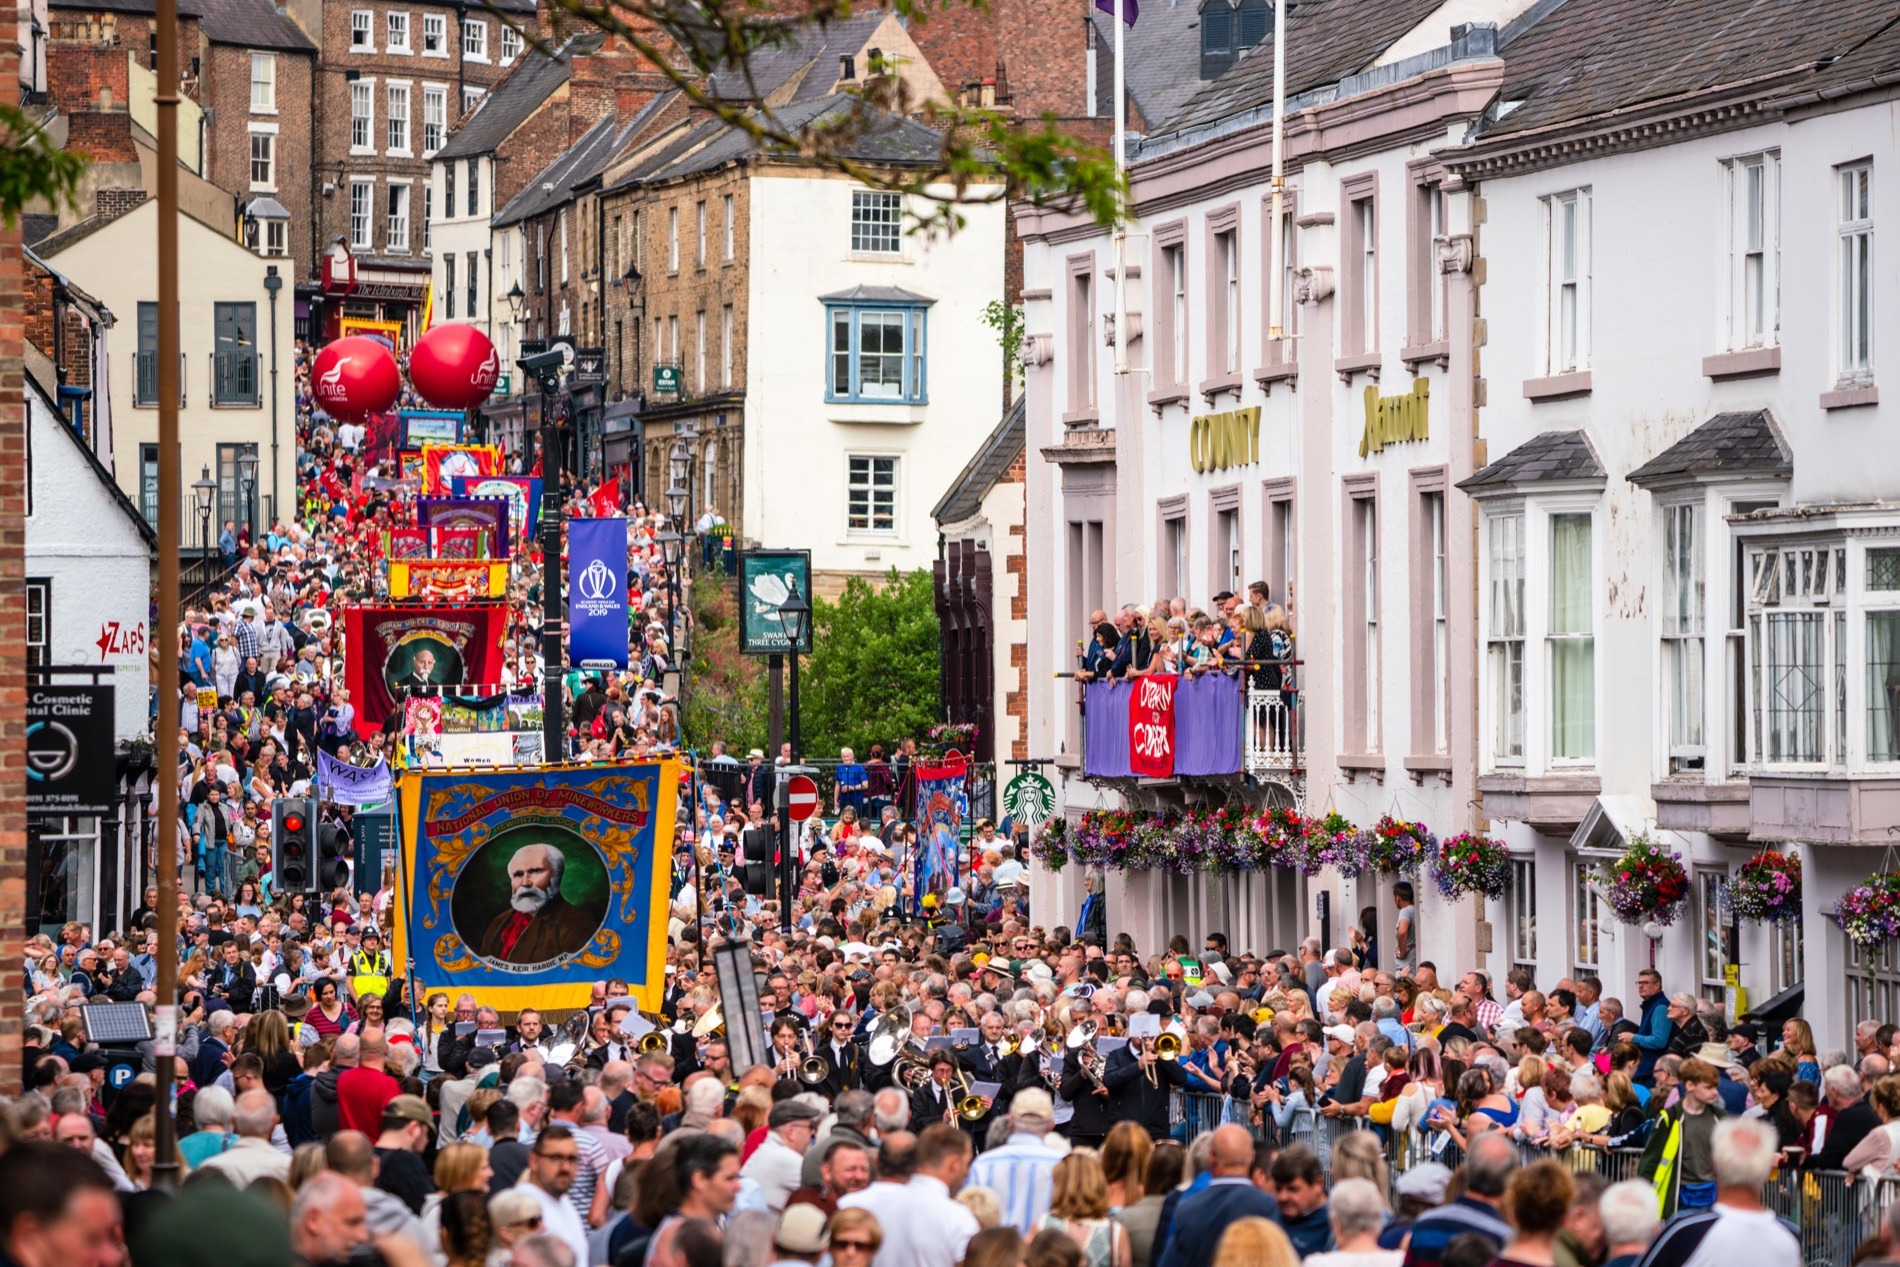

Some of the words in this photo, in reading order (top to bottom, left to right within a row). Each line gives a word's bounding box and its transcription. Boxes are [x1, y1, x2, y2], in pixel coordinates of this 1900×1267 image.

[358, 284, 372, 295] The
[372, 284, 409, 299] Edinburgh
[316, 382, 346, 396] unite
[1359, 376, 1429, 459] Marriott
[1190, 406, 1262, 473] COUNTY
[588, 608, 608, 616] 2019
[376, 622, 402, 633] DURHAM
[432, 619, 474, 633] ASSOCIATION
[108, 621, 144, 654] ZAPS
[749, 638, 769, 646] THREE
[771, 638, 805, 646] CYGNTS
[33, 692, 93, 705] Cosmetic
[25, 705, 49, 715] ntal
[52, 704, 91, 715] Clinic
[436, 805, 490, 834] NATIONAL
[493, 791, 530, 808] UNION
[536, 790, 550, 799] OF
[558, 790, 638, 822] MINEWORKERS
[509, 800, 542, 809] DURHAM
[493, 816, 540, 834] HEWORTH
[546, 816, 578, 830] LODGE
[487, 957, 509, 971] JAMES
[532, 959, 557, 972] HARDIE
[115, 1069, 131, 1085] P
